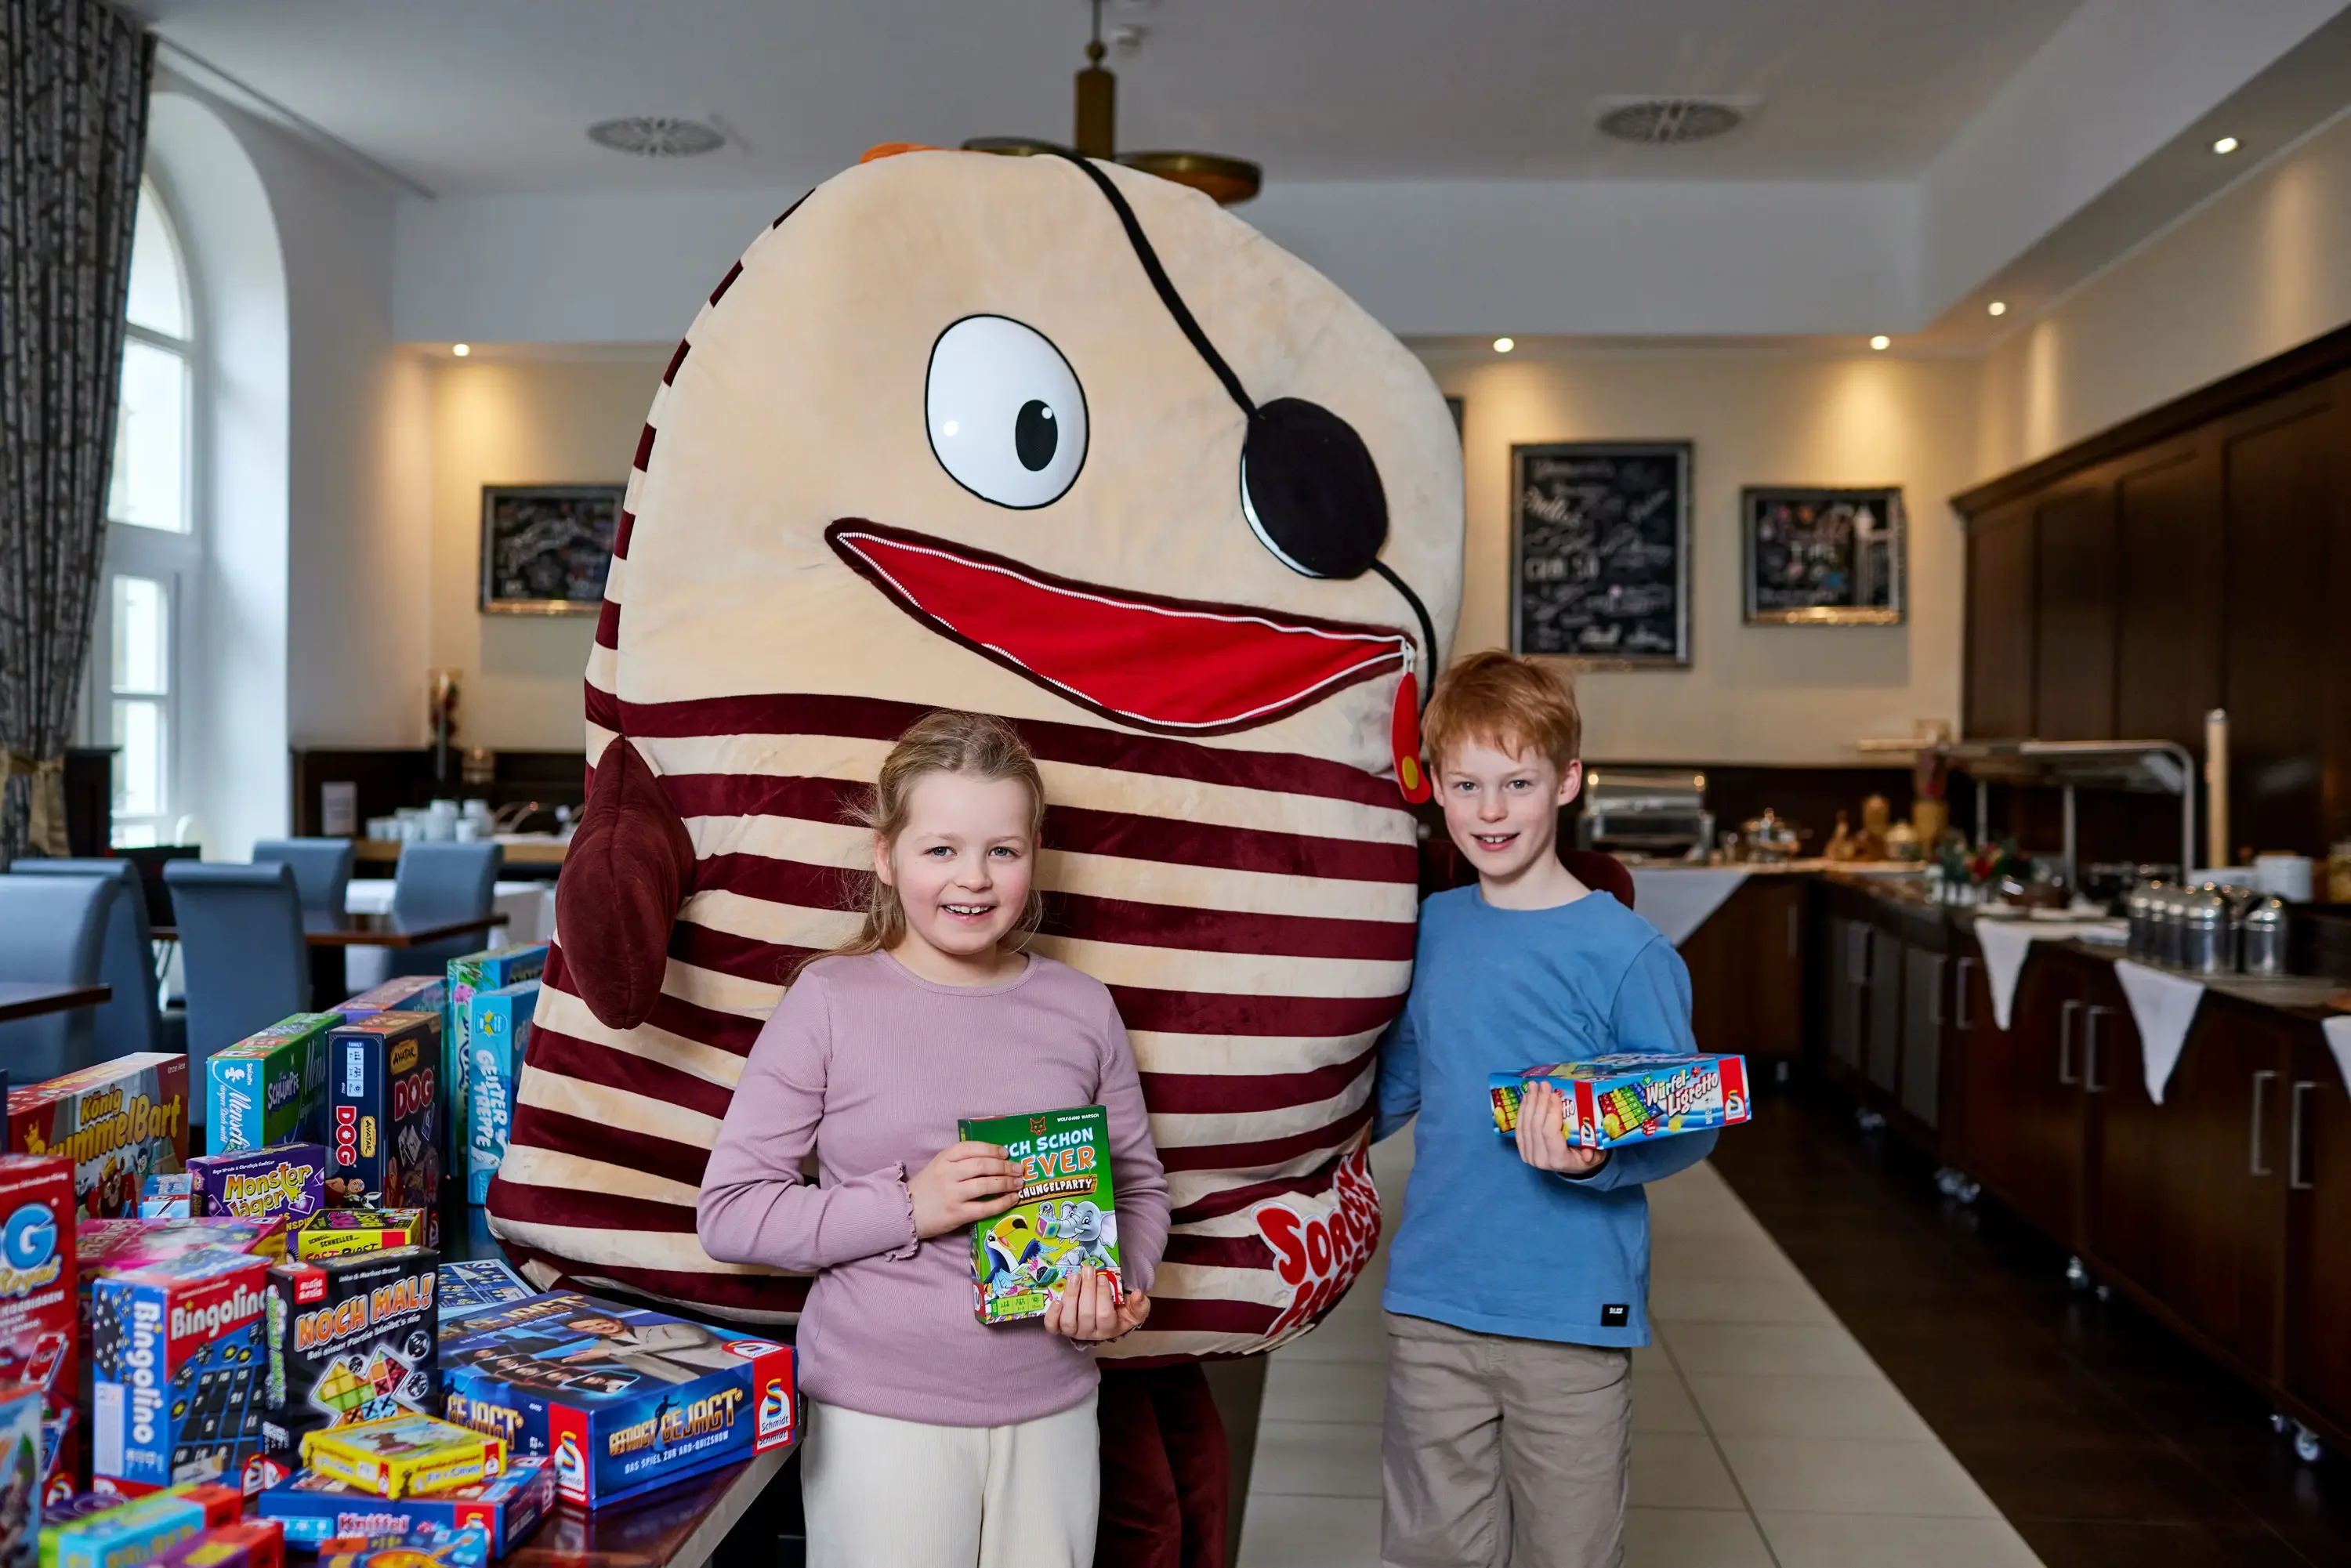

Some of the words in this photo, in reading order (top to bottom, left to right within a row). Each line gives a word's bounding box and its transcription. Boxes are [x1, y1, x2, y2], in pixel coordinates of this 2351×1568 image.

[393, 1046, 417, 1065] AVATAR
[80, 1084, 124, 1125] König
[394, 1068, 434, 1122] DOG
[476, 1049, 508, 1126] GEISTER
[1646, 1069, 1691, 1107] Würfel-
[1666, 1072, 1719, 1117] Ligretto
[227, 1091, 252, 1148] Mensch
[336, 1106, 357, 1167] DOG
[365, 1119, 374, 1156] AVATAR
[473, 1081, 494, 1149] TREPPE
[1035, 1126, 1095, 1153] SCHON
[223, 1162, 313, 1202] Monster
[294, 1294, 369, 1353] NOCH
[370, 1272, 437, 1324] MAL!
[306, 1347, 323, 1361] Bei
[323, 1342, 346, 1356] einer
[407, 1313, 422, 1324] nie
[125, 1300, 164, 1444] Bingolino
[661, 1387, 744, 1443] GEJAGT
[761, 1415, 789, 1432] Schmidt
[625, 1460, 639, 1474] DAS
[640, 1454, 661, 1468] SPIEL
[663, 1447, 677, 1461] ZUR
[678, 1429, 730, 1456] ARD-QUIZSHOW
[337, 1512, 411, 1534] Kniffel
